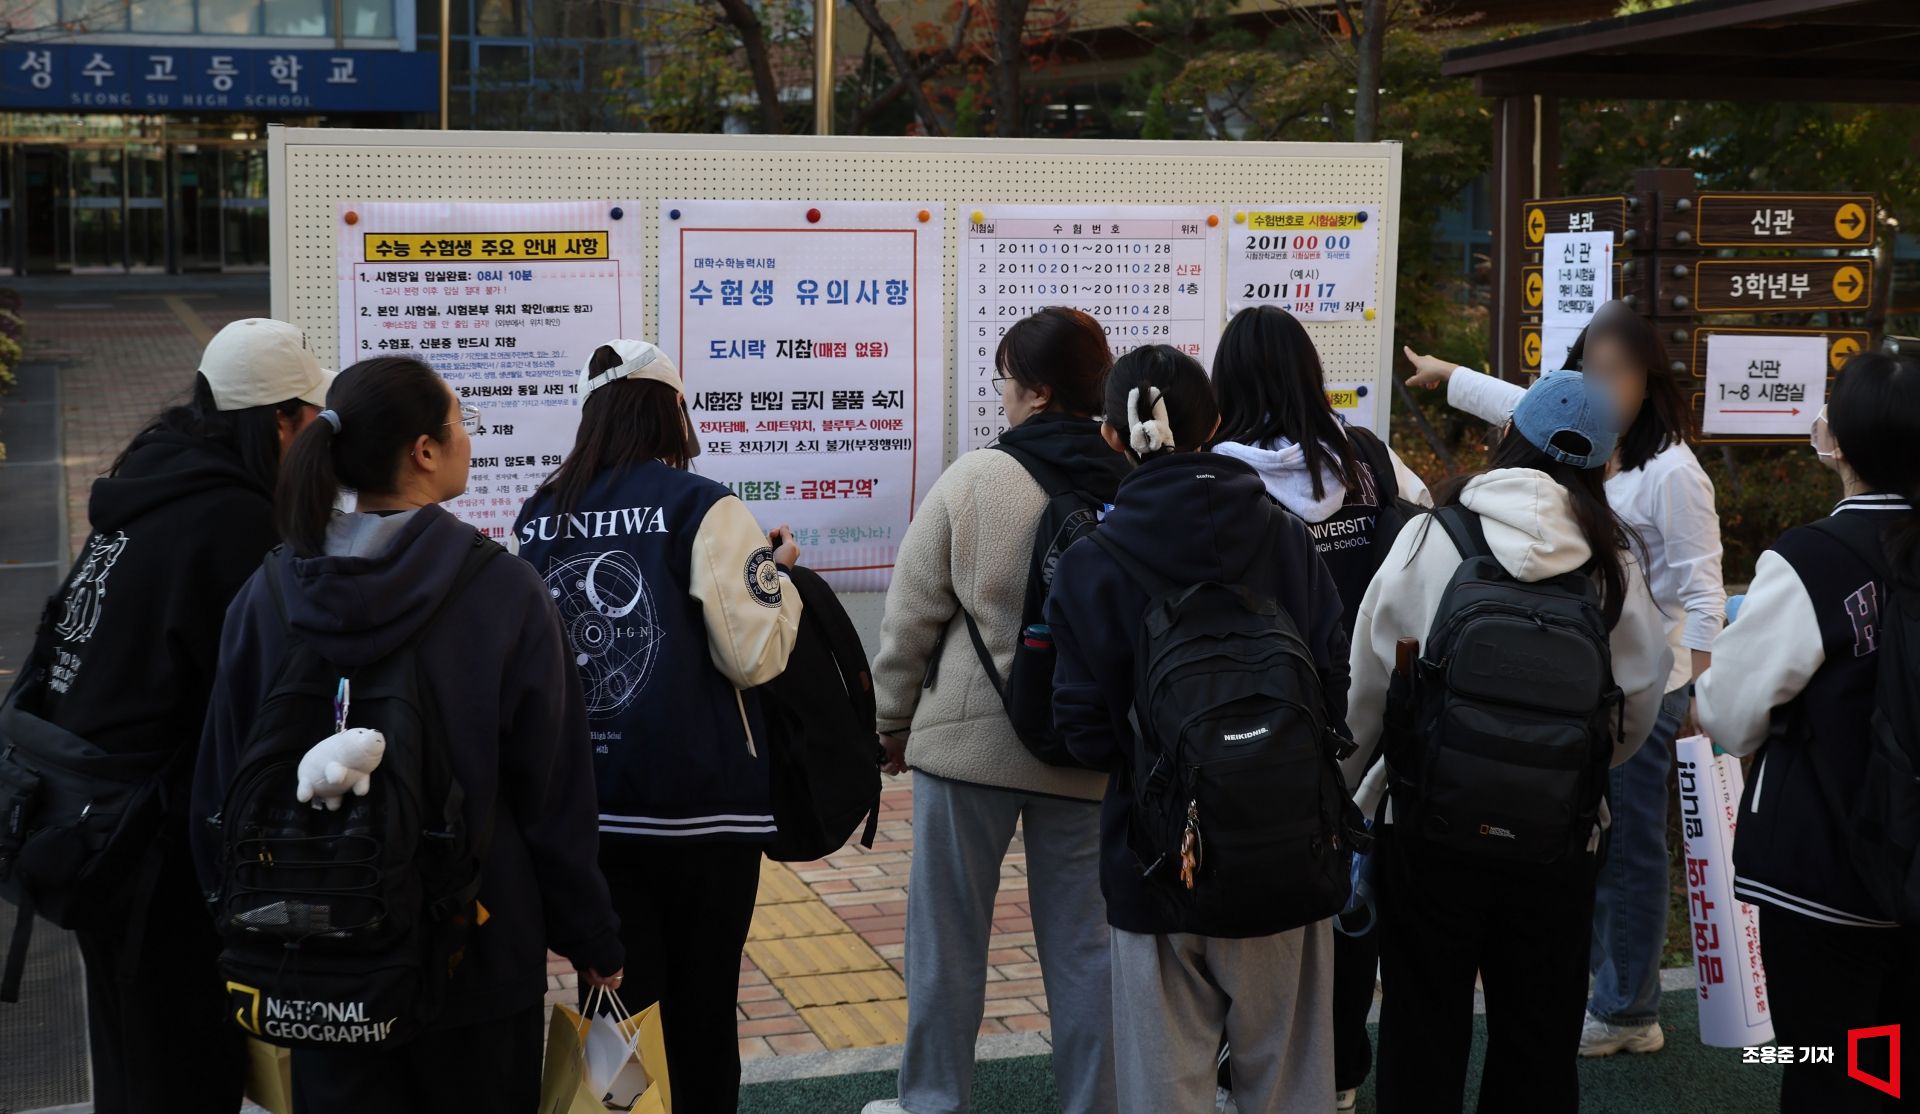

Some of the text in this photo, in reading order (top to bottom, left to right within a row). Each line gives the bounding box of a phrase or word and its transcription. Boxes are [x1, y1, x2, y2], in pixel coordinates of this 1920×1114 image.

[20, 50, 358, 93] 성수고등학교
[71, 92, 312, 107] SEONG SU HIGH SCHOOL
[1254, 215, 1304, 227] 수험번호로
[1568, 211, 1594, 232] 본관
[1751, 209, 1795, 235] 신관
[970, 223, 995, 234] 시험실
[1181, 224, 1198, 235] 위치
[376, 238, 598, 257] 수능 수험생 주요 안내 사항
[980, 243, 985, 253] 1
[1246, 235, 1350, 250] 2011 00 00
[694, 258, 776, 269] 대학수학능력시험
[979, 263, 986, 273] 2
[1176, 264, 1201, 276] 신관
[375, 271, 419, 283] 시험당일
[425, 271, 471, 282] 입실완료:
[477, 270, 502, 282] 08시
[508, 269, 532, 281] 10분
[1574, 268, 1595, 281] 시험실
[690, 279, 909, 306] 수험생 유의사항
[979, 284, 986, 294] 3
[1177, 283, 1199, 295] 4층
[1243, 283, 1336, 299] 2011 11 17
[1574, 284, 1593, 297] 시험실
[1729, 273, 1810, 300] 3학년부
[361, 306, 372, 317] 2.
[377, 305, 399, 317] 본인
[446, 305, 489, 316] 시험본부
[495, 304, 516, 315] 위치
[978, 306, 986, 315] 4
[1295, 301, 1365, 314] 11실 17번 좌석
[979, 327, 986, 336] 5
[361, 339, 373, 350] 3.
[419, 337, 452, 349] 신분증
[457, 337, 489, 348] 반드시
[495, 336, 516, 348] 지참
[709, 339, 766, 359] 도시락
[855, 342, 889, 358] 없음)
[978, 347, 986, 356] 6
[978, 367, 986, 376] 7
[1747, 360, 1781, 379] 신관
[518, 385, 538, 396] 동일
[543, 384, 563, 394] 사진
[978, 387, 986, 396] 8
[1719, 383, 1806, 402] 1~8 시험실
[692, 390, 904, 411] 시험장 반입 금지 물품 숙지
[978, 406, 986, 416] 9
[492, 424, 514, 435] 지참
[700, 419, 903, 433] 전자담배, 스마트워치, 블루투스 이어폰
[973, 426, 990, 436] 10
[708, 441, 732, 453] 모든
[739, 440, 787, 453] 전자기기
[795, 440, 819, 452] 소지
[470, 455, 562, 468] 대하지 않도록 유의
[520, 506, 669, 546] SUNHWA
[1308, 515, 1376, 539] NIVERSITY
[1334, 536, 1371, 550] SCHOOL
[266, 996, 370, 1023] NATIONAL
